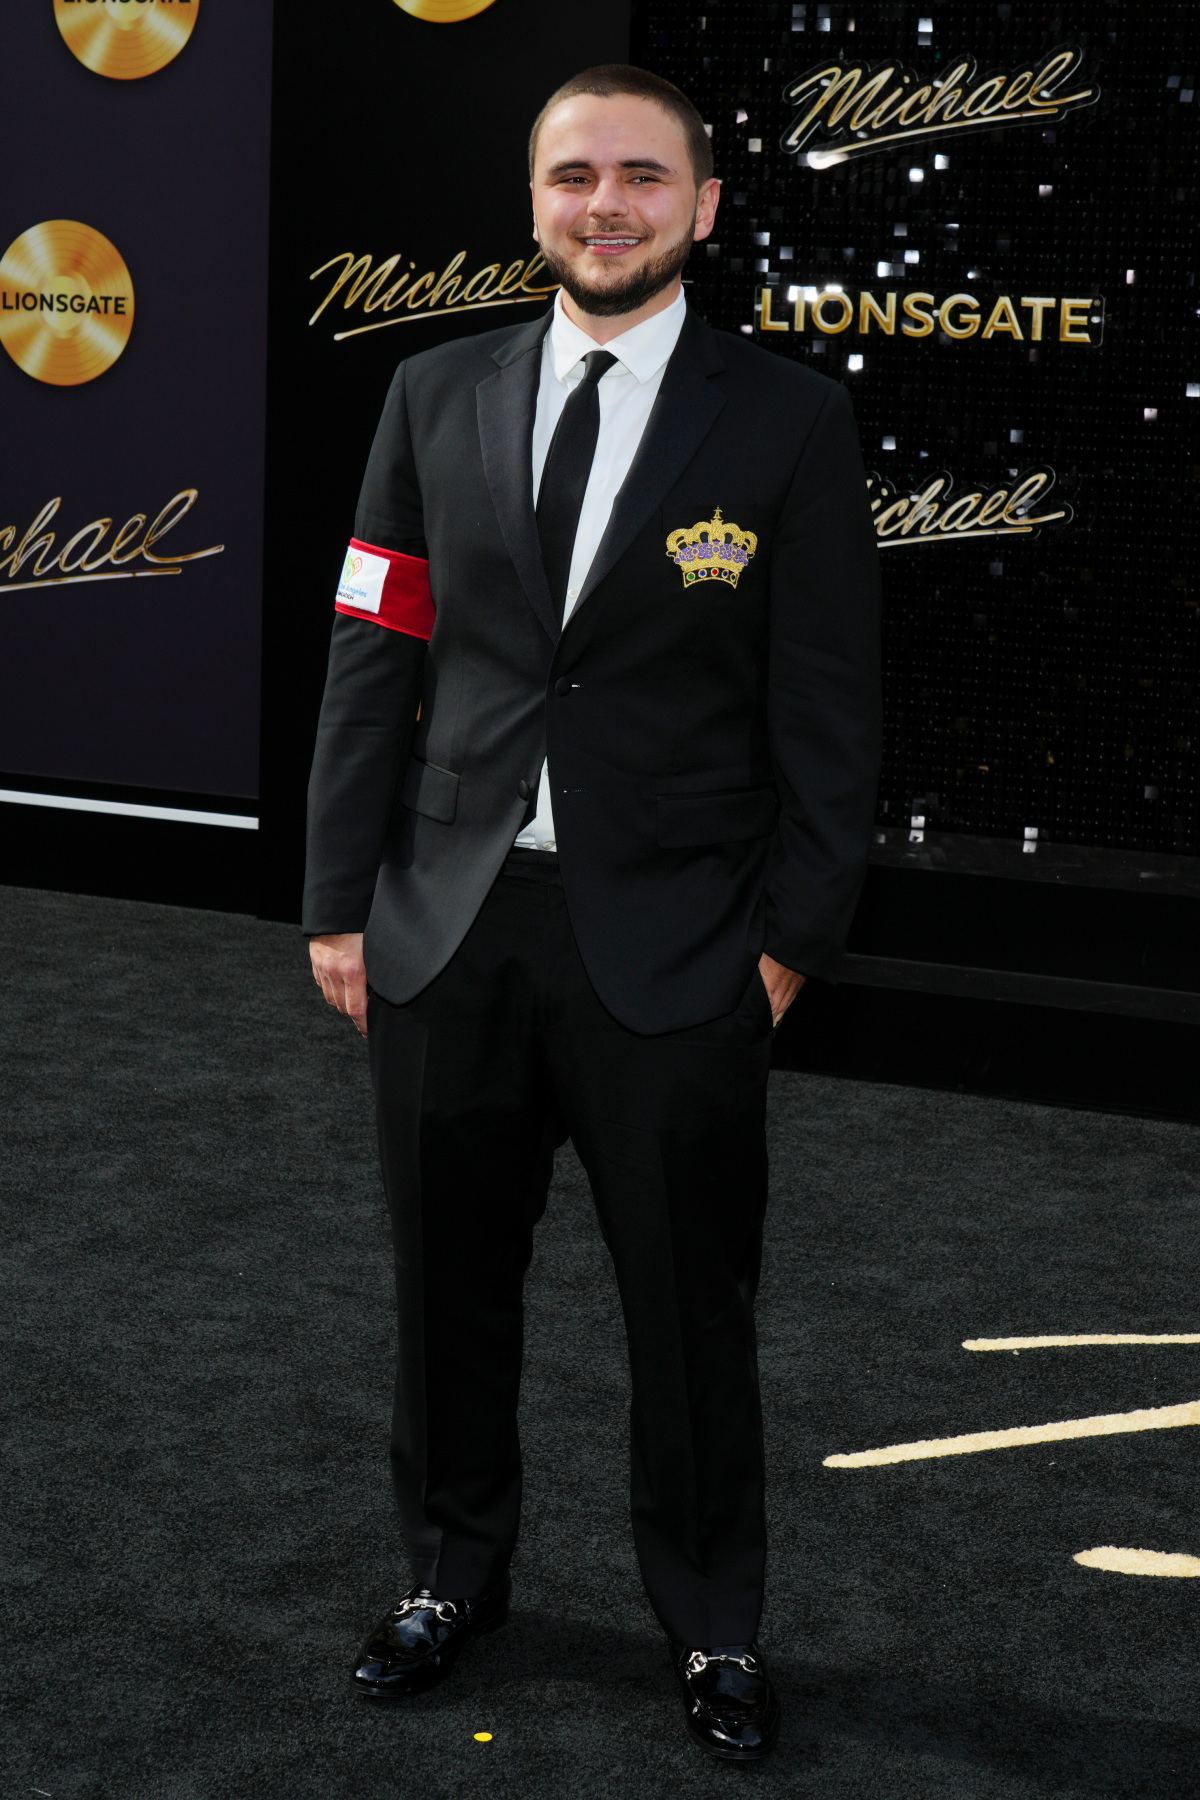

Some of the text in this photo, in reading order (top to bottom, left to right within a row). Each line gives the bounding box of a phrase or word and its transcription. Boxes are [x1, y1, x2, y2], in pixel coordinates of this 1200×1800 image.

[787, 51, 1092, 146] Michael
[2, 291, 128, 315] LIONSGATE
[309, 250, 563, 327] Michael
[760, 287, 1094, 342] LIONSGATE
[346, 585, 367, 598] Angeles
